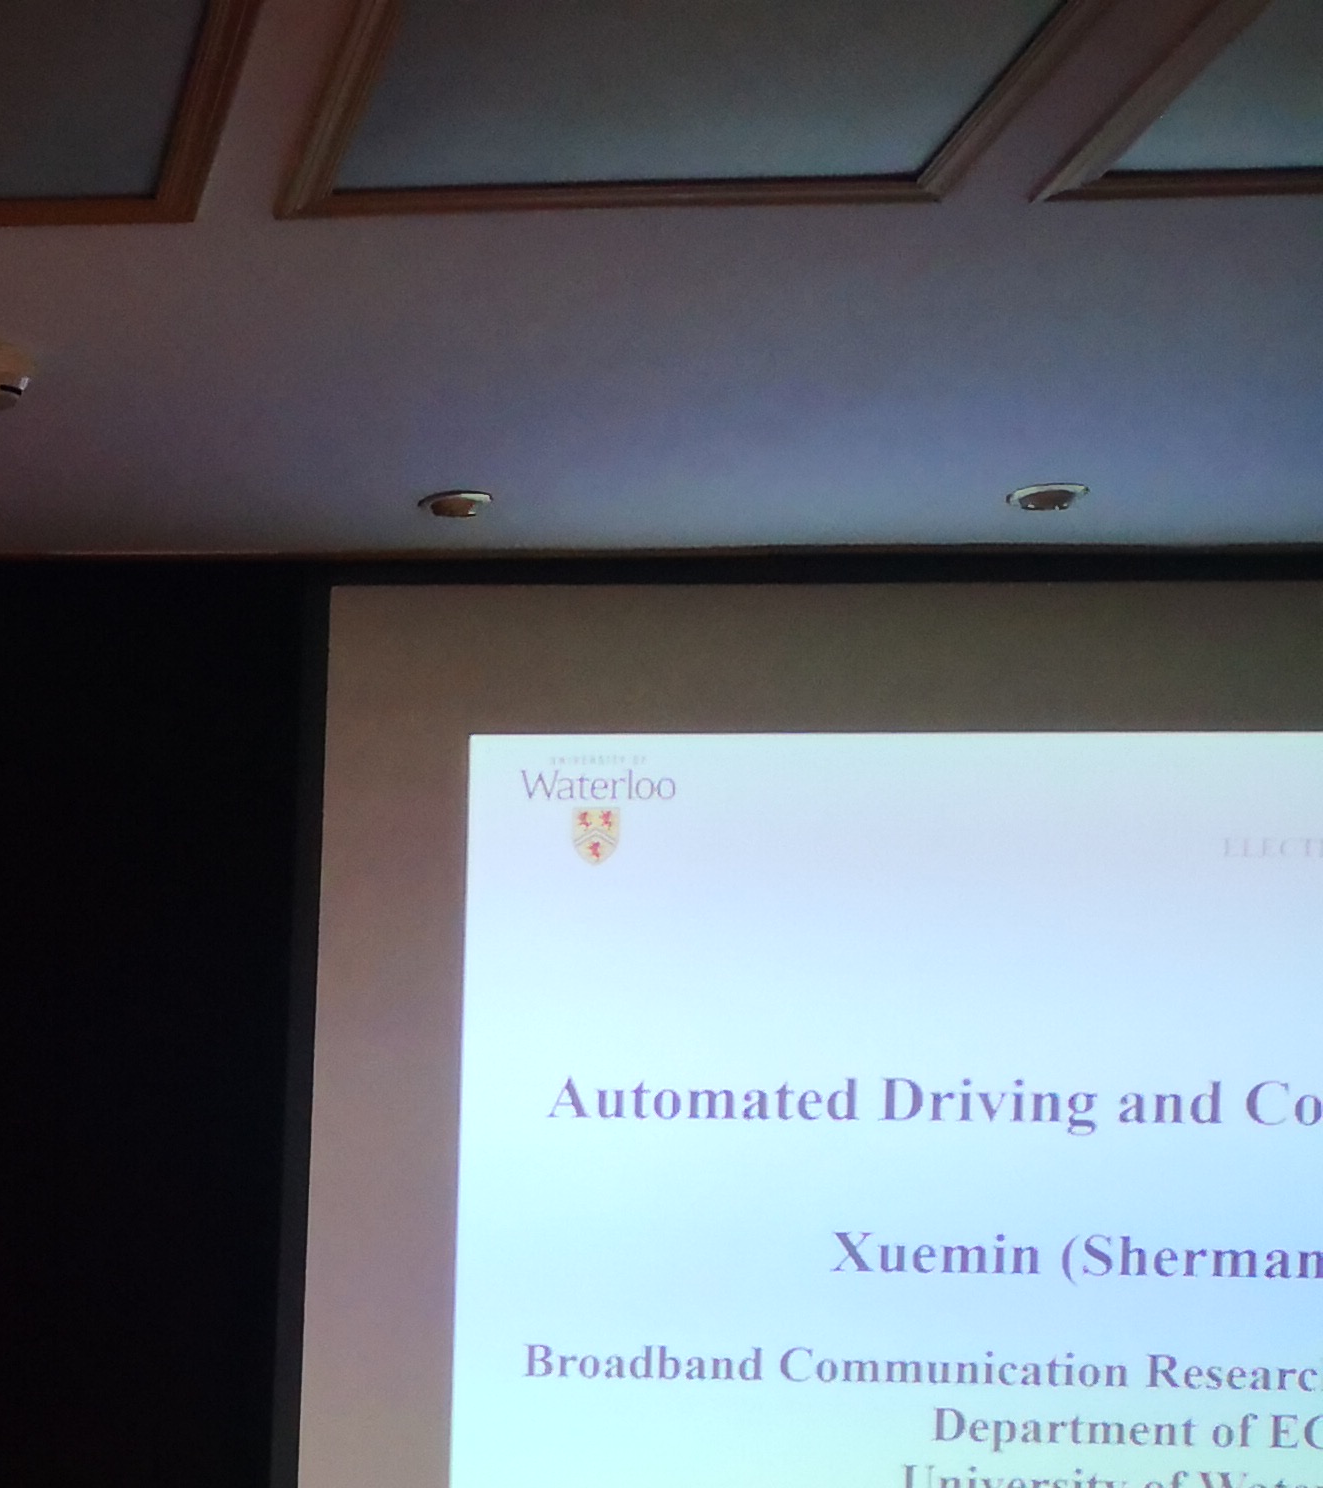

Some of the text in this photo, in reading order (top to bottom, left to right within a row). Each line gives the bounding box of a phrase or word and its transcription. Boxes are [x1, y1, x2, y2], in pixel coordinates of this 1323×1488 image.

[521, 769, 677, 800] Waterloo
[547, 1075, 860, 1121] Automated
[878, 1077, 1098, 1136] Driving
[1119, 1080, 1223, 1125] and
[830, 1231, 1323, 1287] Xuemin (Sherman
[524, 1344, 1323, 1392] Broadband Communication Researc
[933, 1406, 1197, 1453] Department
[1212, 1413, 1259, 1448] of
